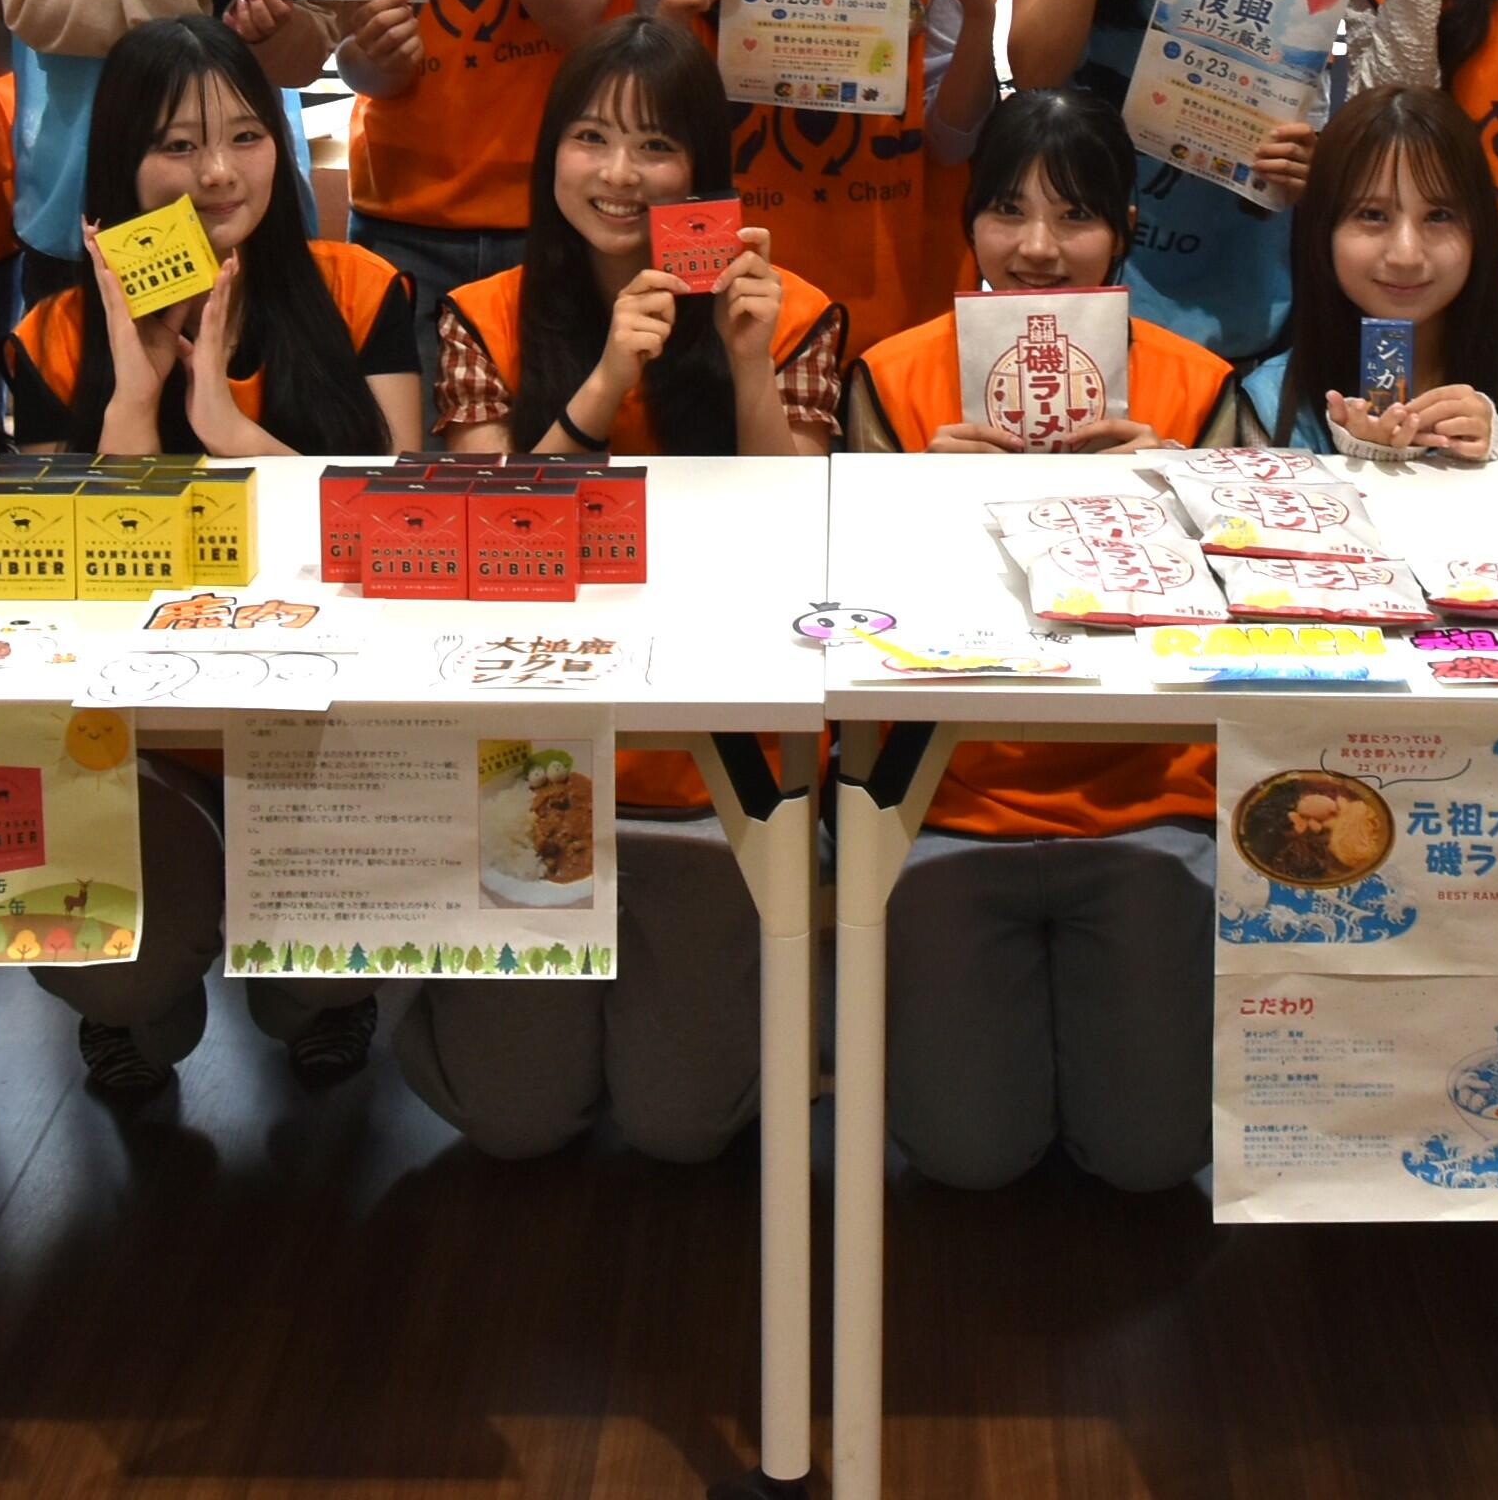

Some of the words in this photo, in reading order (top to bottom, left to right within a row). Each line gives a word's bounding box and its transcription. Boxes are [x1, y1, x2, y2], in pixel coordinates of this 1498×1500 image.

[1181, 8, 1272, 57] チャリティ販売
[737, 188, 783, 211] eijo
[1134, 222, 1201, 255] EIJO
[120, 250, 190, 282] MONTAGNE
[125, 261, 196, 296] GIBIER
[1376, 340, 1398, 390] シカ
[198, 535, 238, 544] AGNE
[586, 533, 636, 541] TAGNE
[86, 550, 172, 559] MONTAGNE
[199, 548, 238, 561] IER
[371, 548, 457, 557] MONTAGNE
[479, 549, 565, 559] MONTAGNE
[581, 545, 636, 559] BIER
[86, 562, 172, 577] GIBIER
[371, 560, 458, 574] GIBIER
[479, 562, 566, 575] GIBIER
[141, 592, 320, 631] 鹿肉
[485, 635, 619, 656] 大槌鹿
[1151, 627, 1387, 657] RAMEN
[473, 654, 595, 674] コク旨
[1438, 890, 1467, 900] BEST
[1239, 997, 1315, 1016] こだわり
